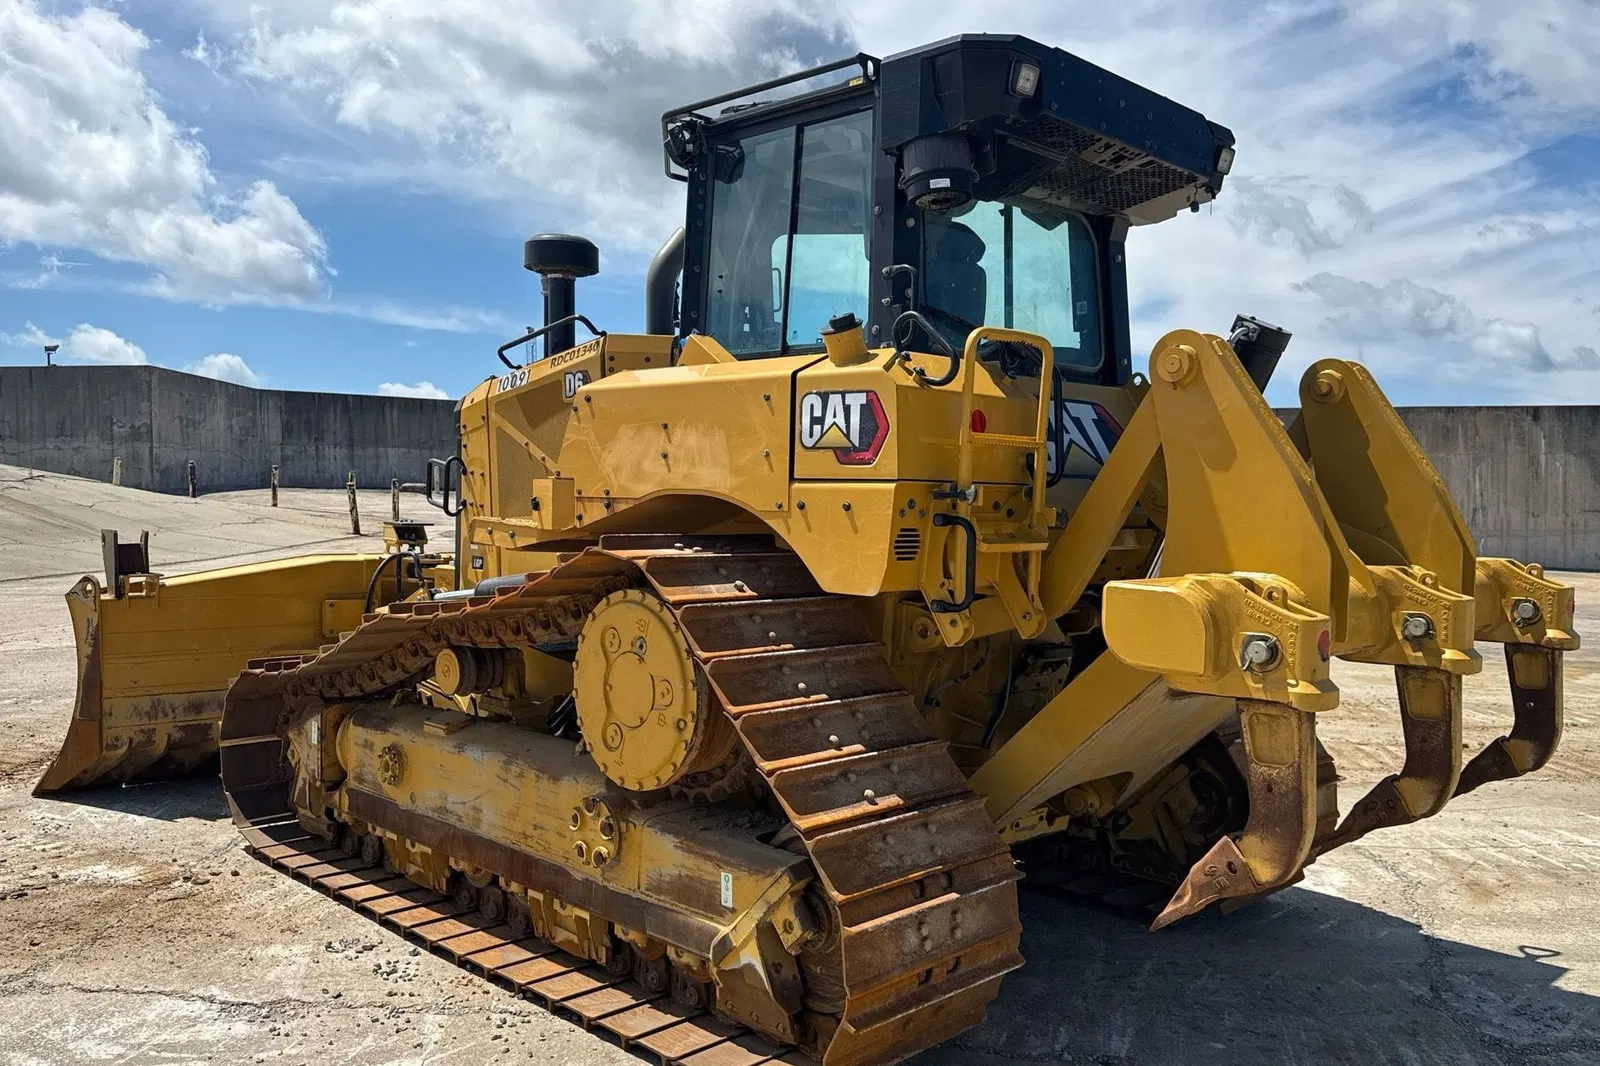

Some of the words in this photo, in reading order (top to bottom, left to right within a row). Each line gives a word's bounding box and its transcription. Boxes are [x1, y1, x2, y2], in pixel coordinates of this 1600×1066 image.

[550, 340, 600, 368] RDC01340
[497, 369, 531, 393] 10091
[565, 371, 584, 398] D6
[801, 392, 867, 447] CAT
